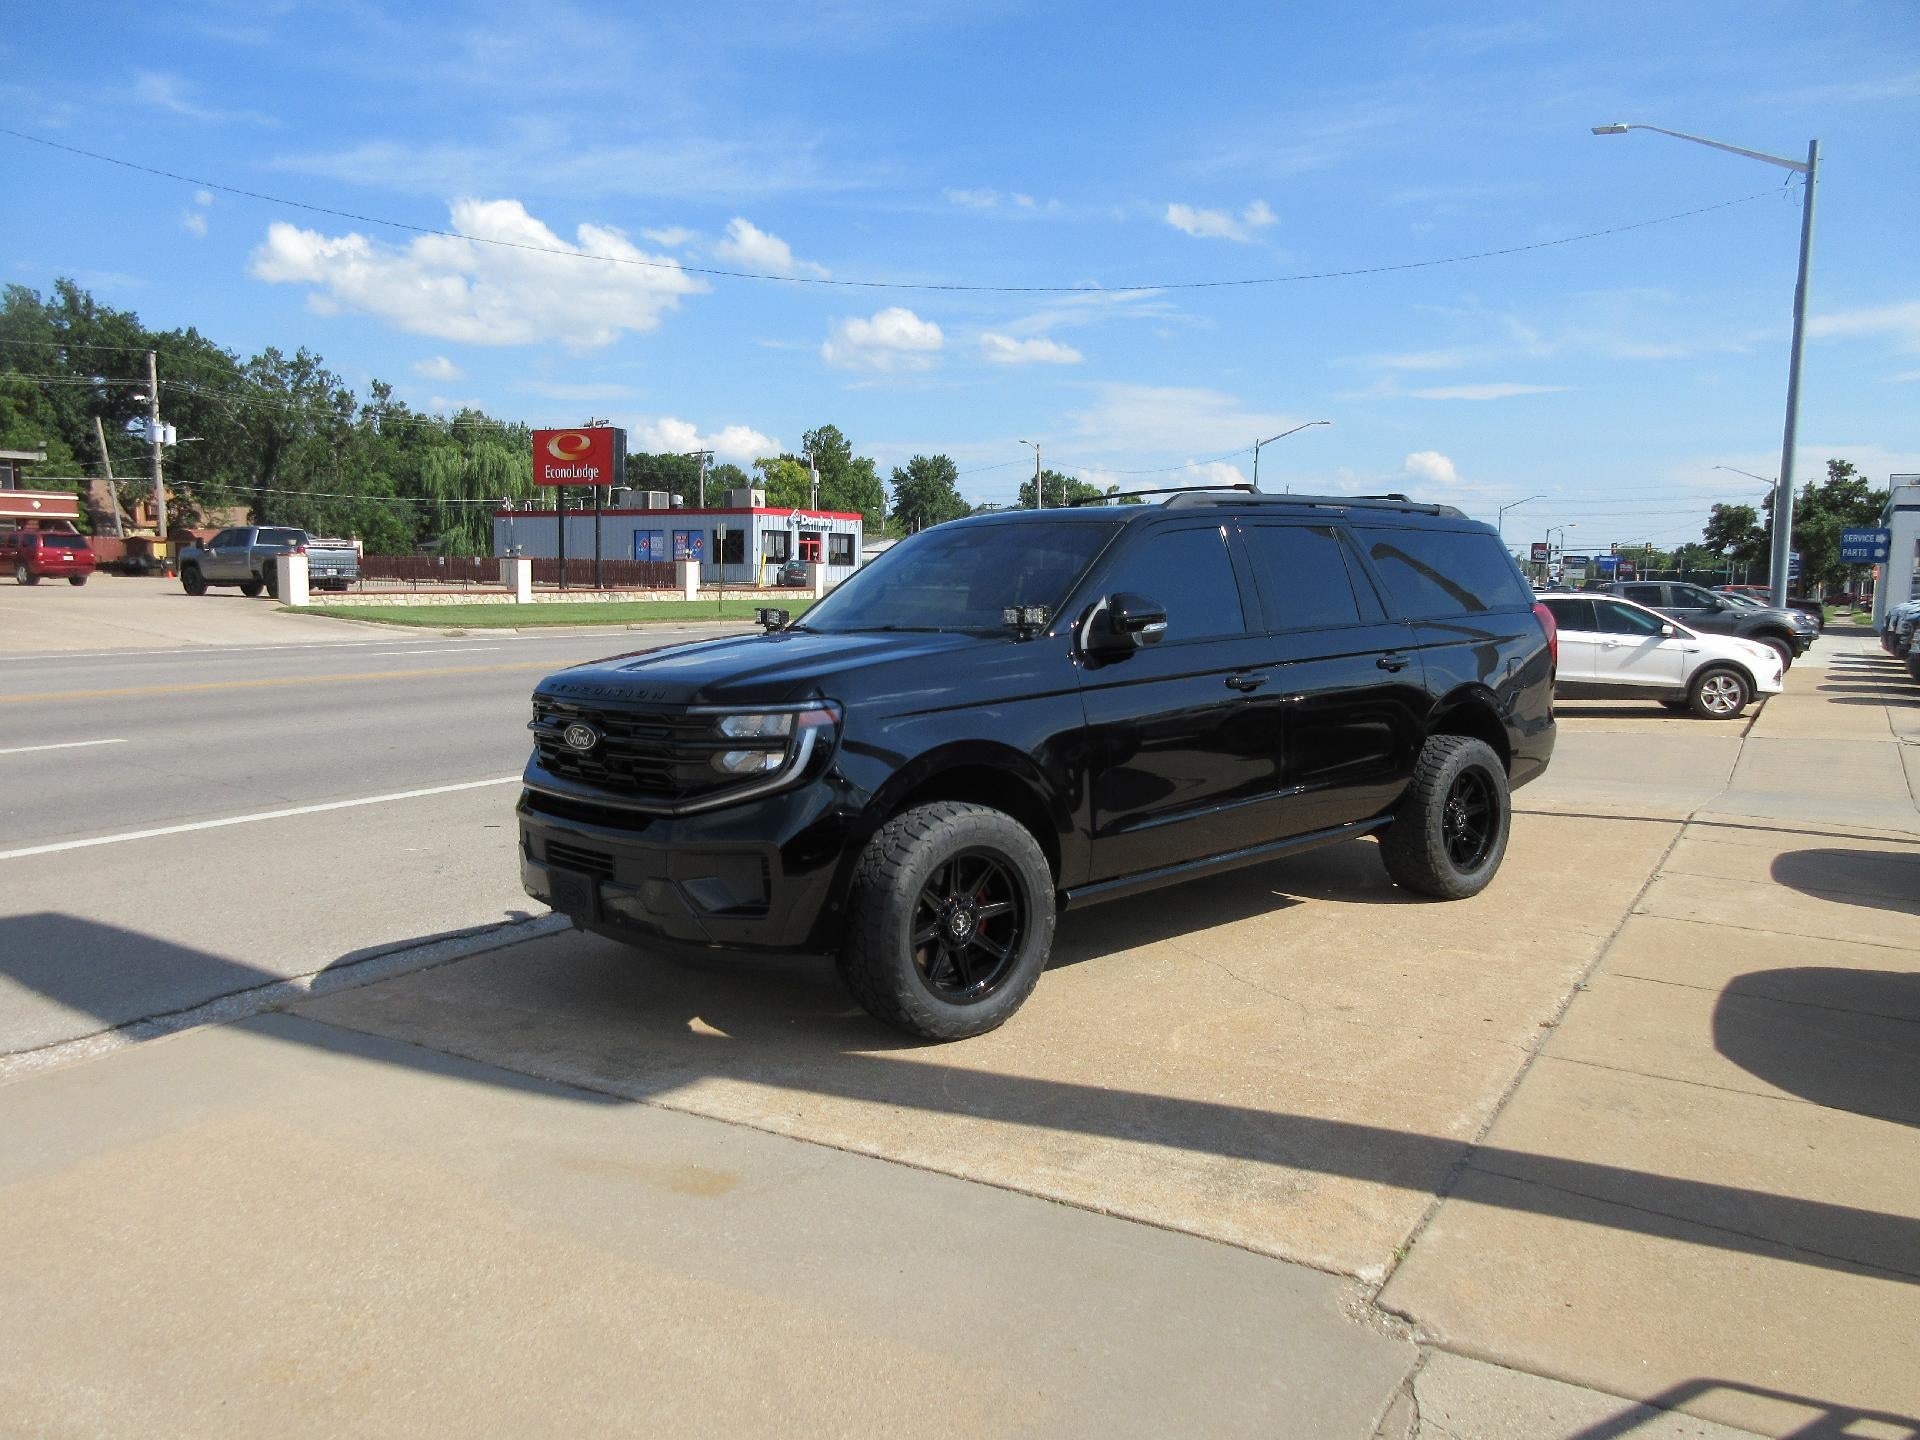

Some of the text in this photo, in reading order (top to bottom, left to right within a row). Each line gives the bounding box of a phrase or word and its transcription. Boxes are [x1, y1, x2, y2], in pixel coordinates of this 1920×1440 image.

[545, 464, 599, 481] EconoLodge
[1843, 534, 1874, 543] SERVICE
[1842, 549, 1867, 557] PARTS
[570, 727, 589, 746] Ford
